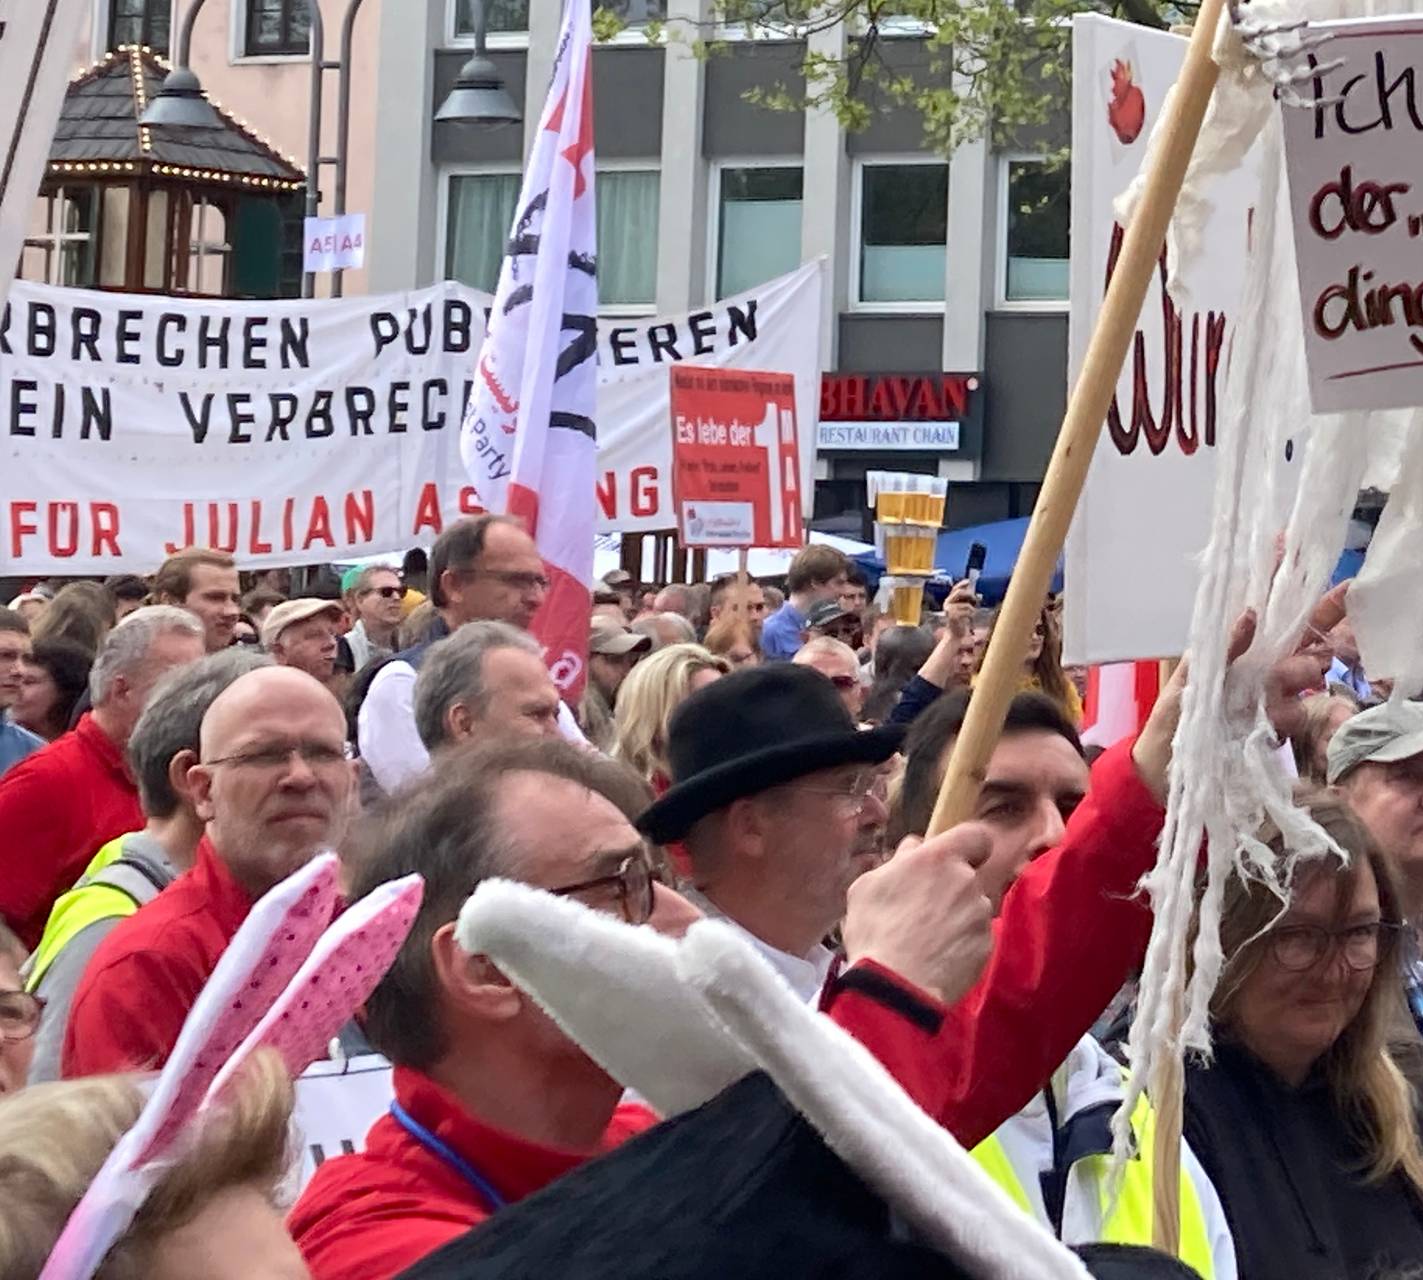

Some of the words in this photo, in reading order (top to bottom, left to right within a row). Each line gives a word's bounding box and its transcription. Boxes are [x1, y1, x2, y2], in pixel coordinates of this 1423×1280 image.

[1309, 165, 1412, 240] der
[10, 379, 112, 441] EIN
[822, 375, 968, 418] BHAVAN
[676, 415, 695, 445] Es
[697, 416, 727, 446] lebe
[729, 418, 752, 447] der
[820, 426, 911, 444] RESTAURANT
[913, 426, 955, 444] CHAIN
[10, 501, 122, 558] FÜR
[165, 490, 375, 554] JULIAN
